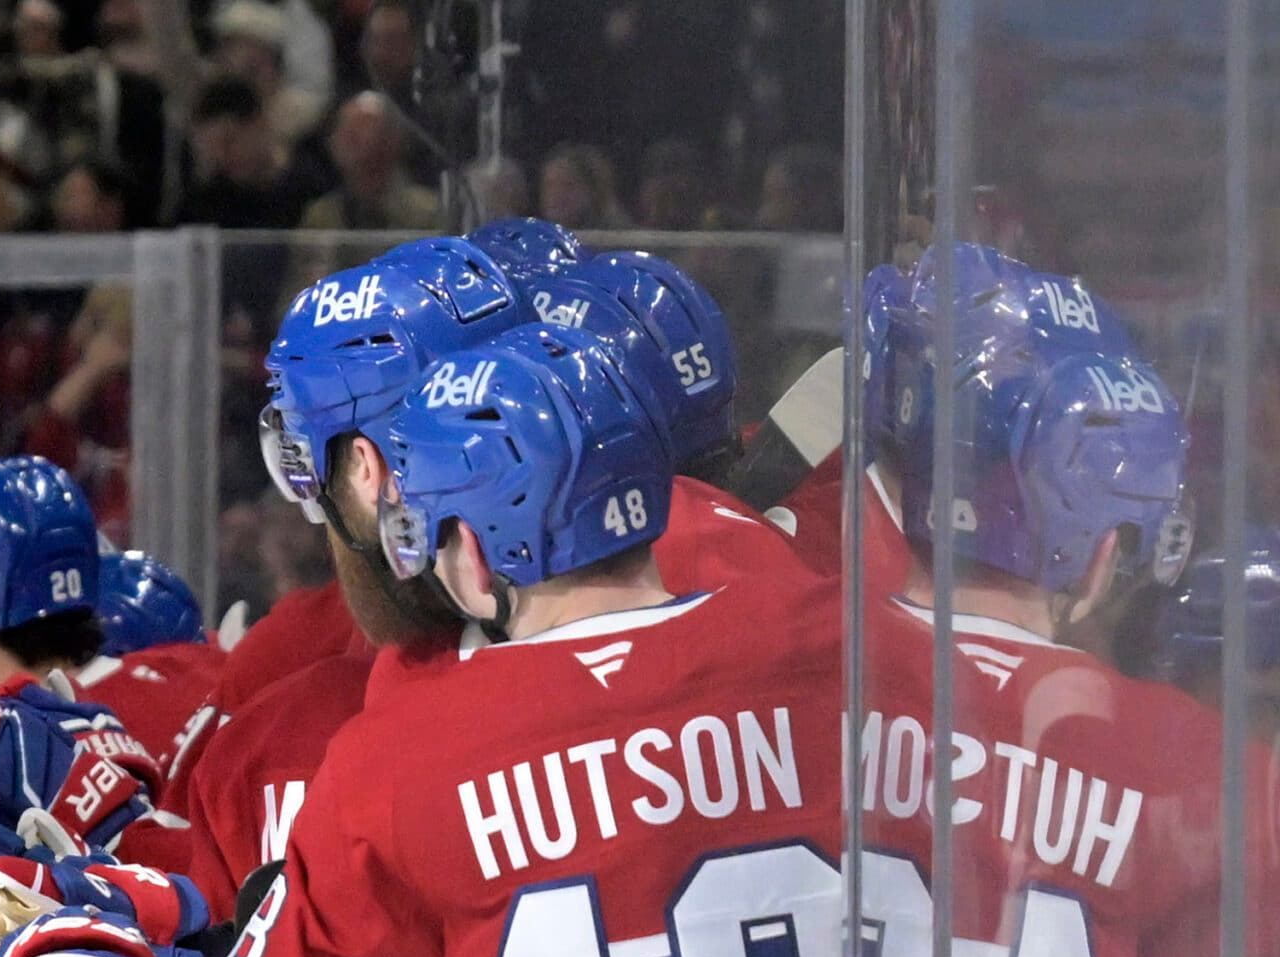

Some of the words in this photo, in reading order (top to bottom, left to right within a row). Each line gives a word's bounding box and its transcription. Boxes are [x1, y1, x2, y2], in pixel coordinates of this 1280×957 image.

[314, 275, 380, 327] Bell
[427, 360, 497, 408] Bell
[672, 342, 712, 386] 55
[604, 488, 648, 537] 48
[50, 569, 82, 602] 20
[458, 707, 802, 879] HUTSON
